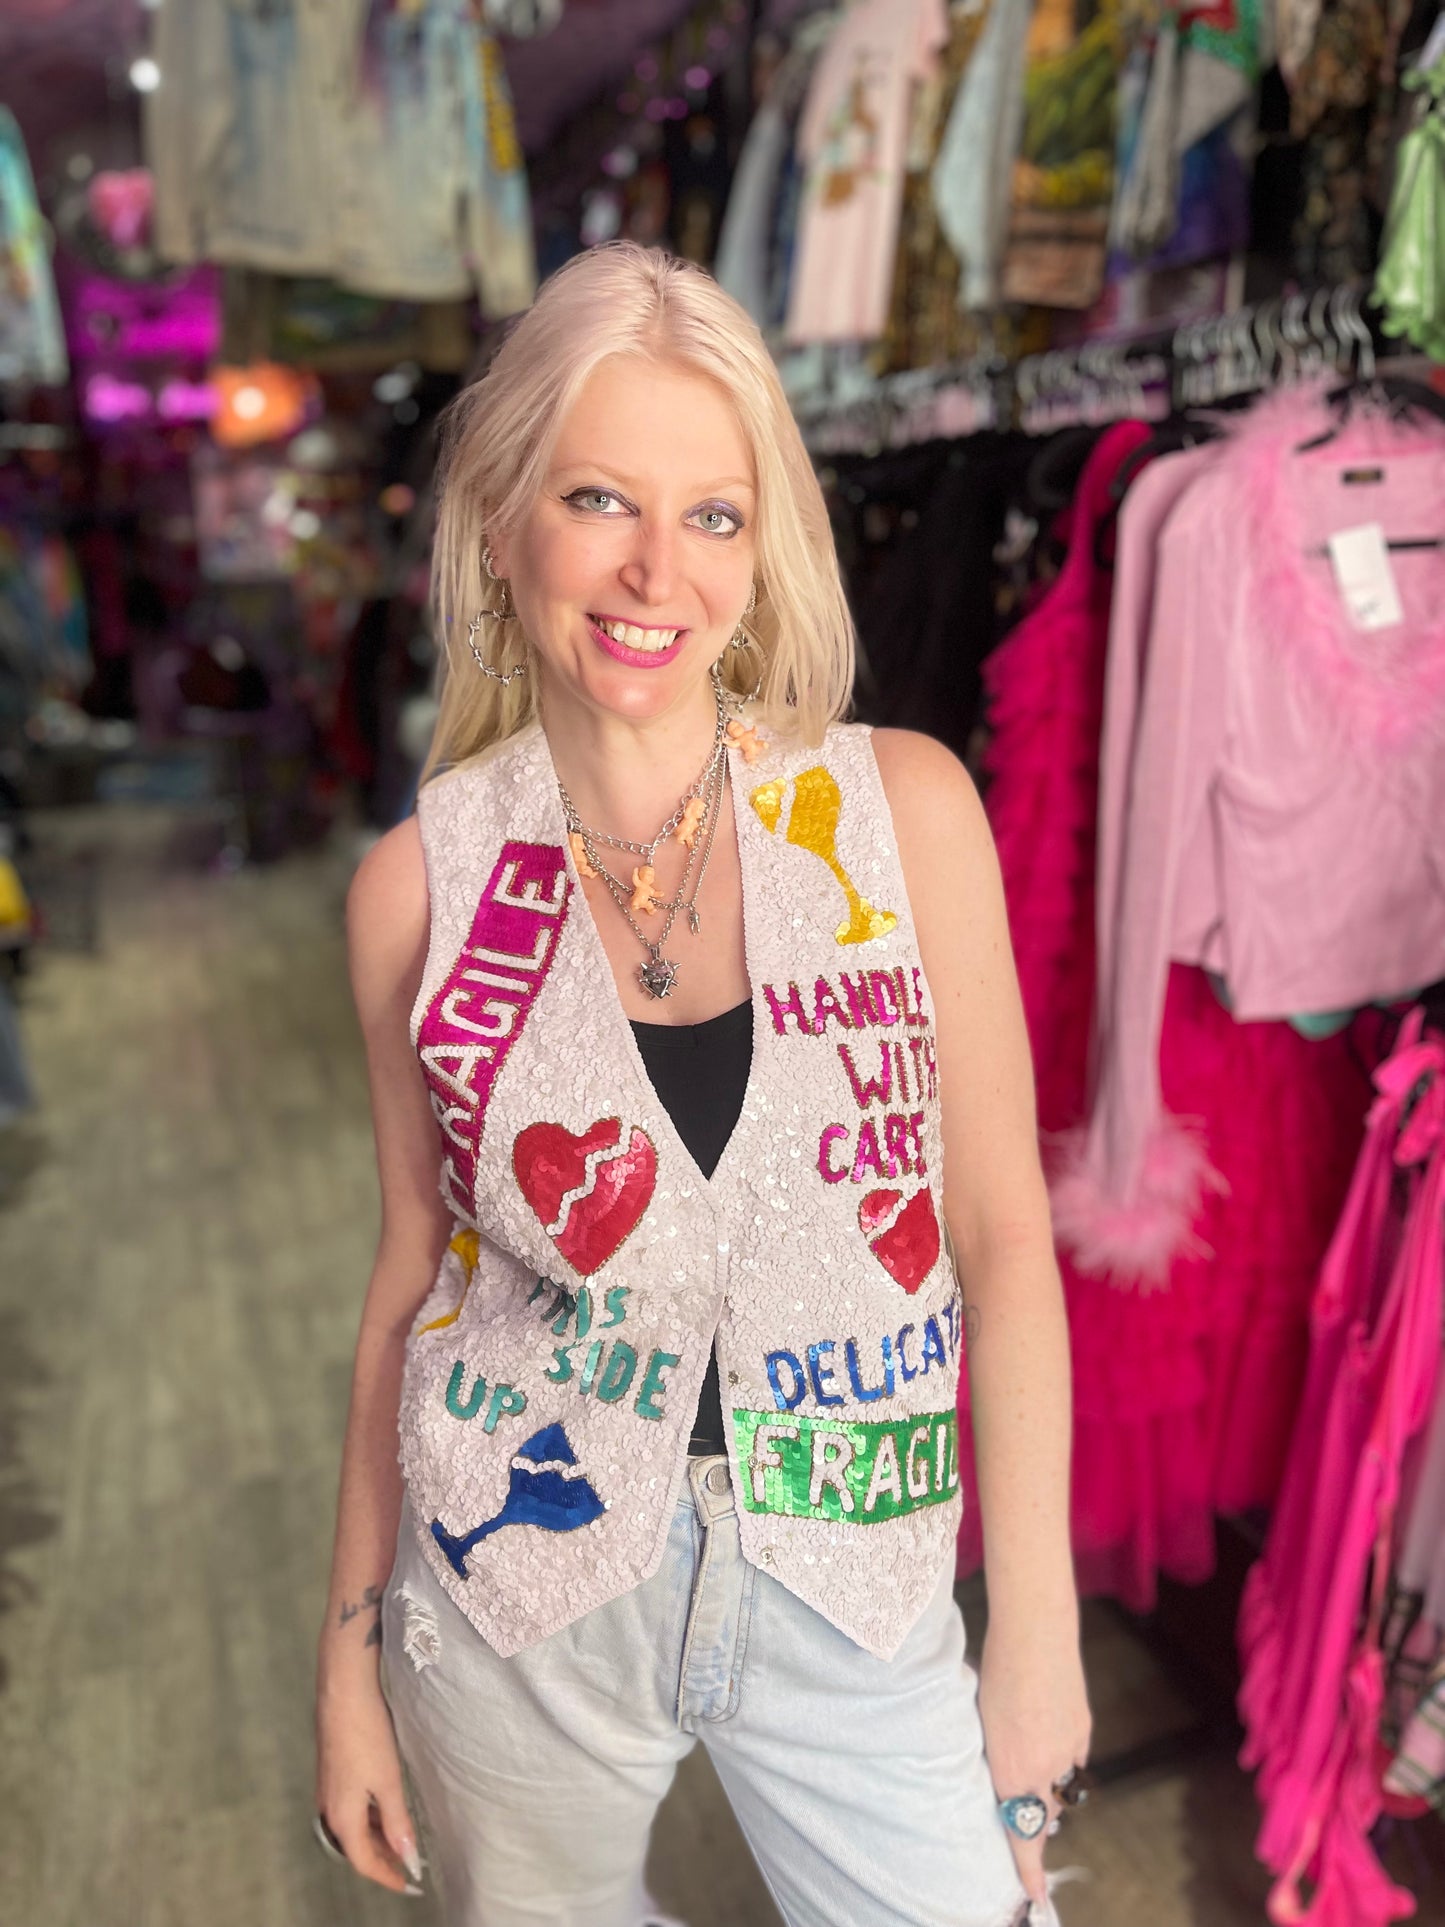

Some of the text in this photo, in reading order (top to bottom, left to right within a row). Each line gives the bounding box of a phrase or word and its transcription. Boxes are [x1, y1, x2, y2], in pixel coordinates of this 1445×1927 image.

[544, 1340, 682, 1421] SIDE
[765, 1296, 960, 1410] DELICAT
[445, 1360, 527, 1434] UP
